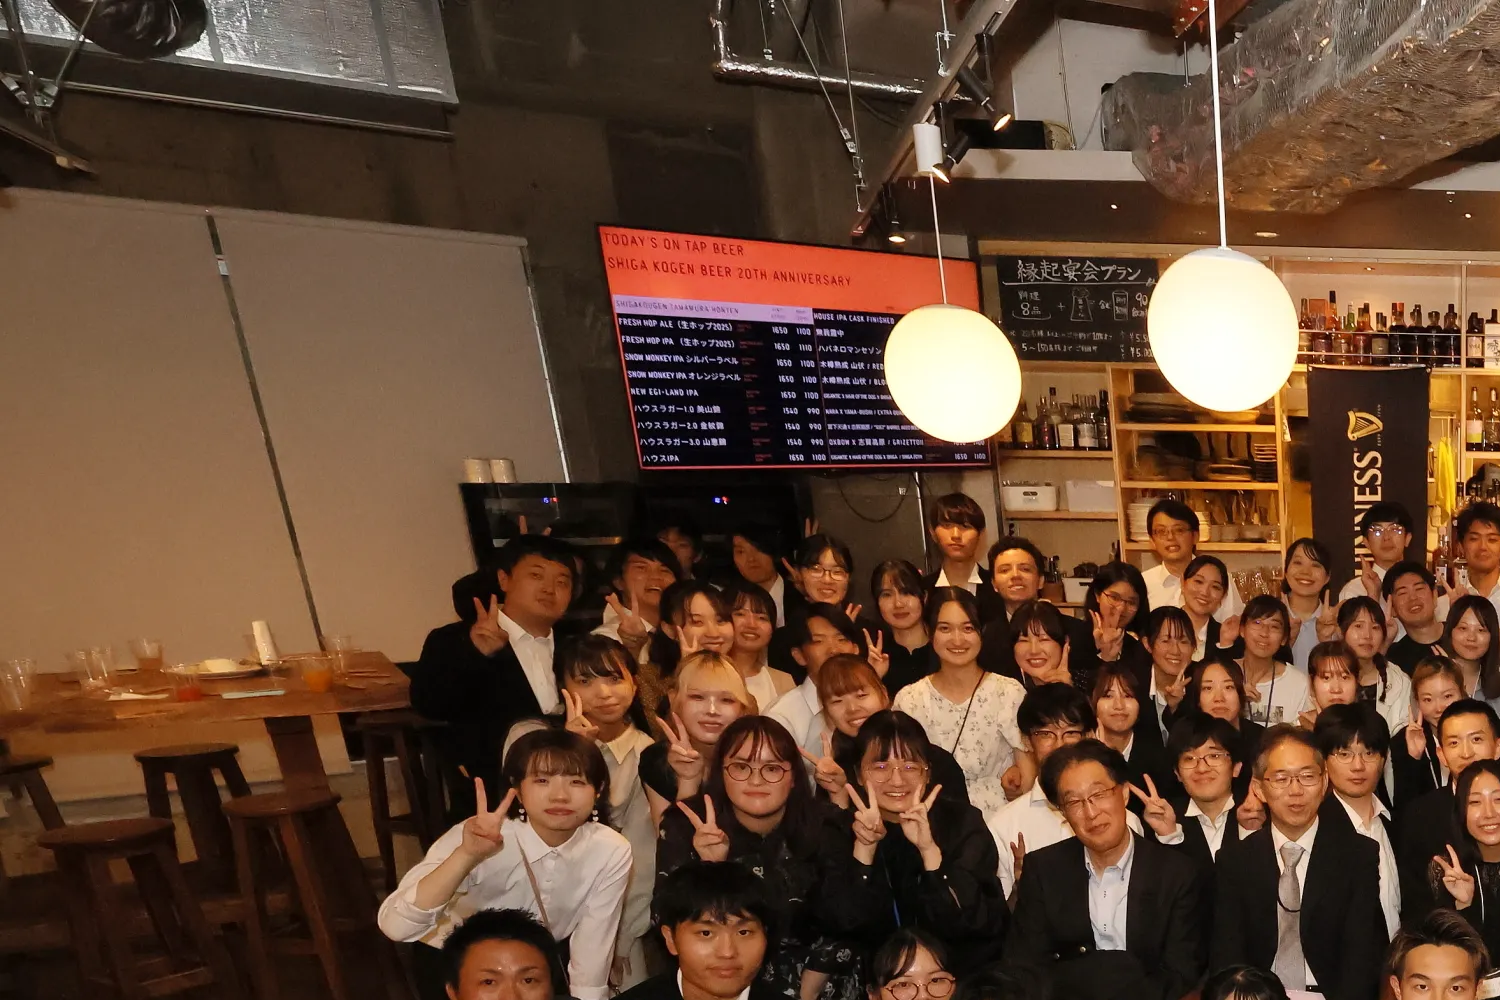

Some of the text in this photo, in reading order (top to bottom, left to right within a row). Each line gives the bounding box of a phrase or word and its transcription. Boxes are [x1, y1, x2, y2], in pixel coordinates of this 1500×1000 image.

[604, 233, 744, 256] TODAY'S ON TAP BEER
[607, 257, 852, 287] SHIGA KOGEN BEER 20TH ANNIVERSARY
[1017, 258, 1142, 283] 縁起宴会プラン
[618, 317, 643, 327] FRESH
[642, 318, 659, 328] HOP
[659, 319, 674, 329] ALE
[814, 312, 834, 321] HOUSE
[836, 314, 848, 322] IPA
[866, 316, 895, 325] FINISHED
[772, 326, 788, 335] 1650
[796, 327, 811, 336] 1100
[621, 335, 645, 345] FRESH
[645, 336, 661, 345] HOP
[662, 337, 675, 346] IPA
[774, 342, 790, 351] 1650
[624, 353, 645, 361] SNOW
[645, 353, 673, 363] MONKEY
[673, 354, 685, 363] IPA
[777, 359, 815, 368] 1650 1100
[627, 370, 647, 379] SNOW
[648, 371, 676, 379] MONKEY
[675, 372, 688, 380] IPA
[688, 372, 742, 381] オレンジラベル
[779, 375, 817, 384] 1650 1100
[630, 387, 647, 396] NEW
[686, 389, 699, 397] IPA
[781, 391, 797, 399] 1650
[783, 407, 799, 415] 1540
[787, 438, 824, 446] 1540 990
